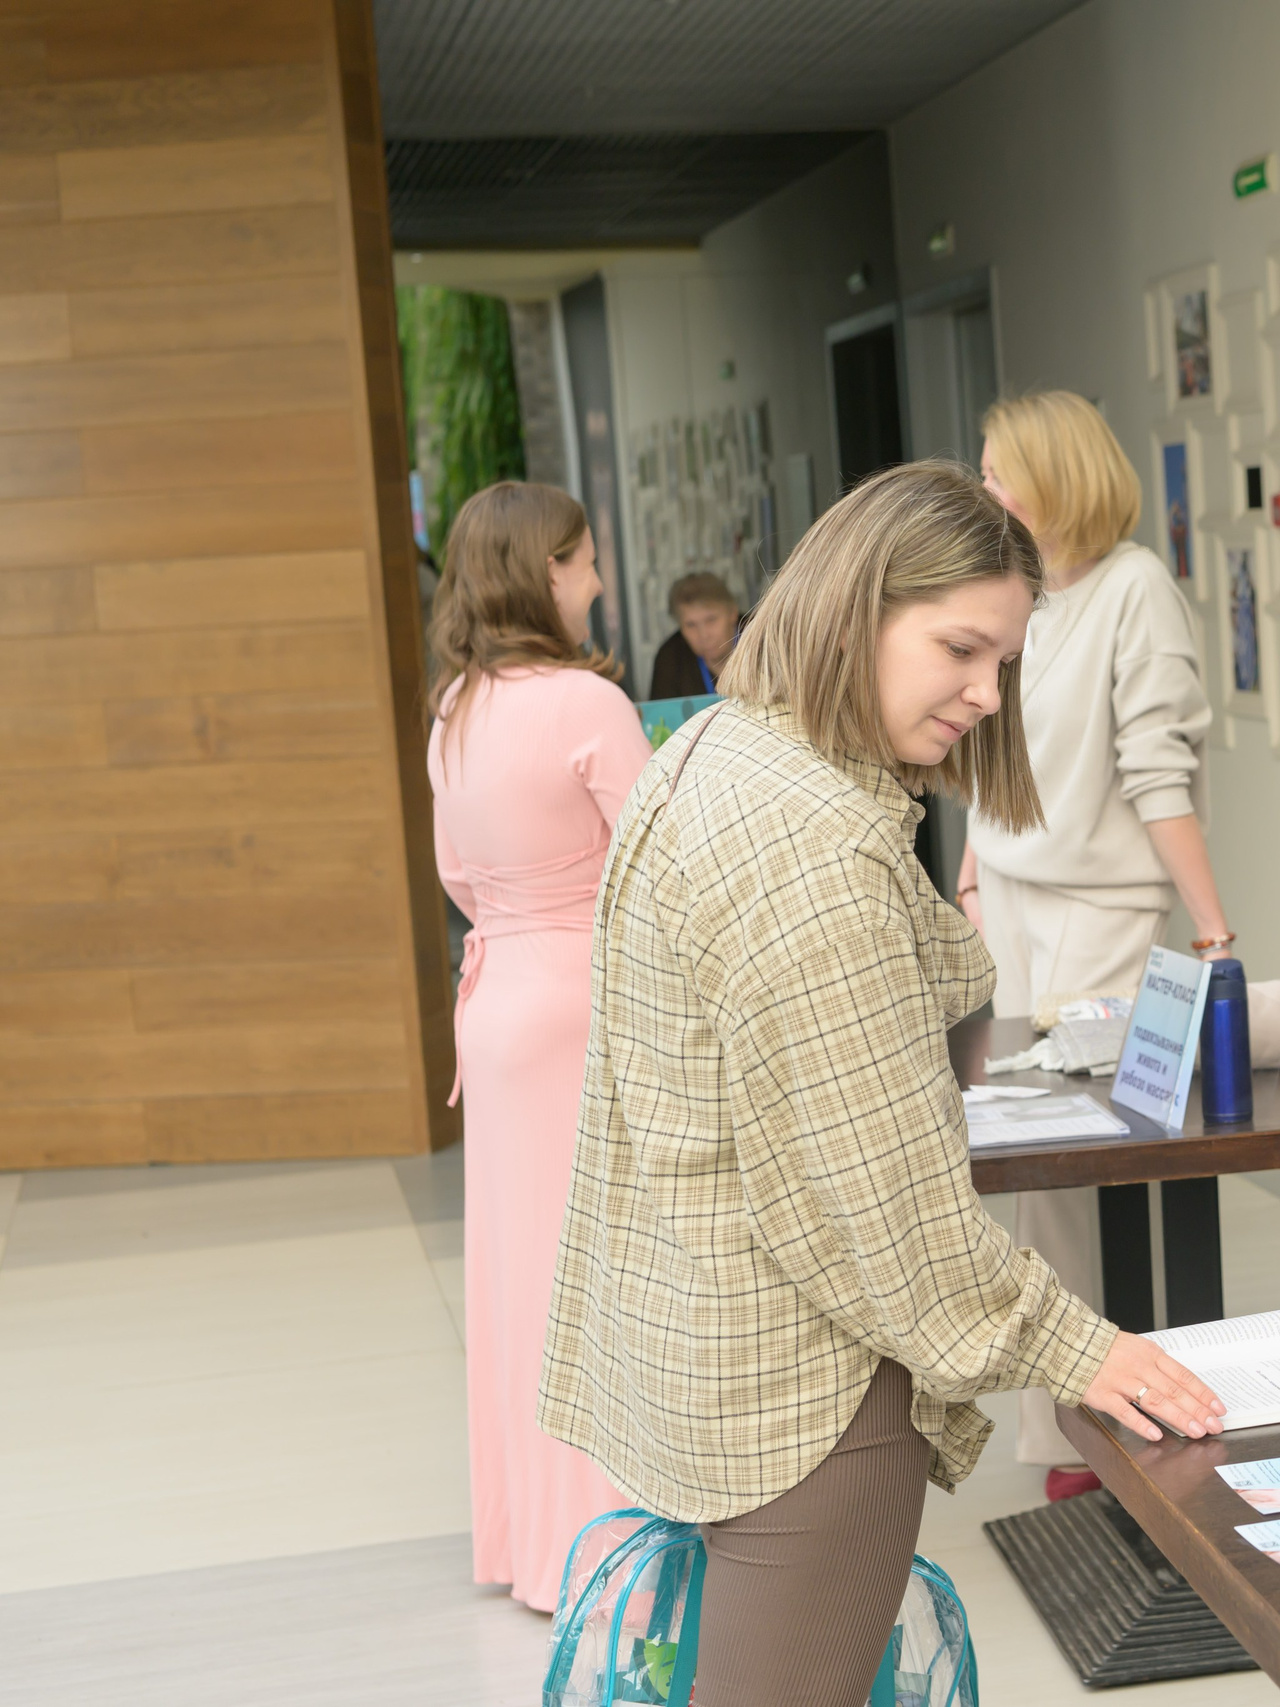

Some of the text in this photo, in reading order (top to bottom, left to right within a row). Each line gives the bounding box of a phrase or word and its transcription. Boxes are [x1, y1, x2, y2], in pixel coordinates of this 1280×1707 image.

[1146, 973, 1196, 1005] МАСТЕР-КЛАСС
[1136, 1052, 1168, 1075] живота и
